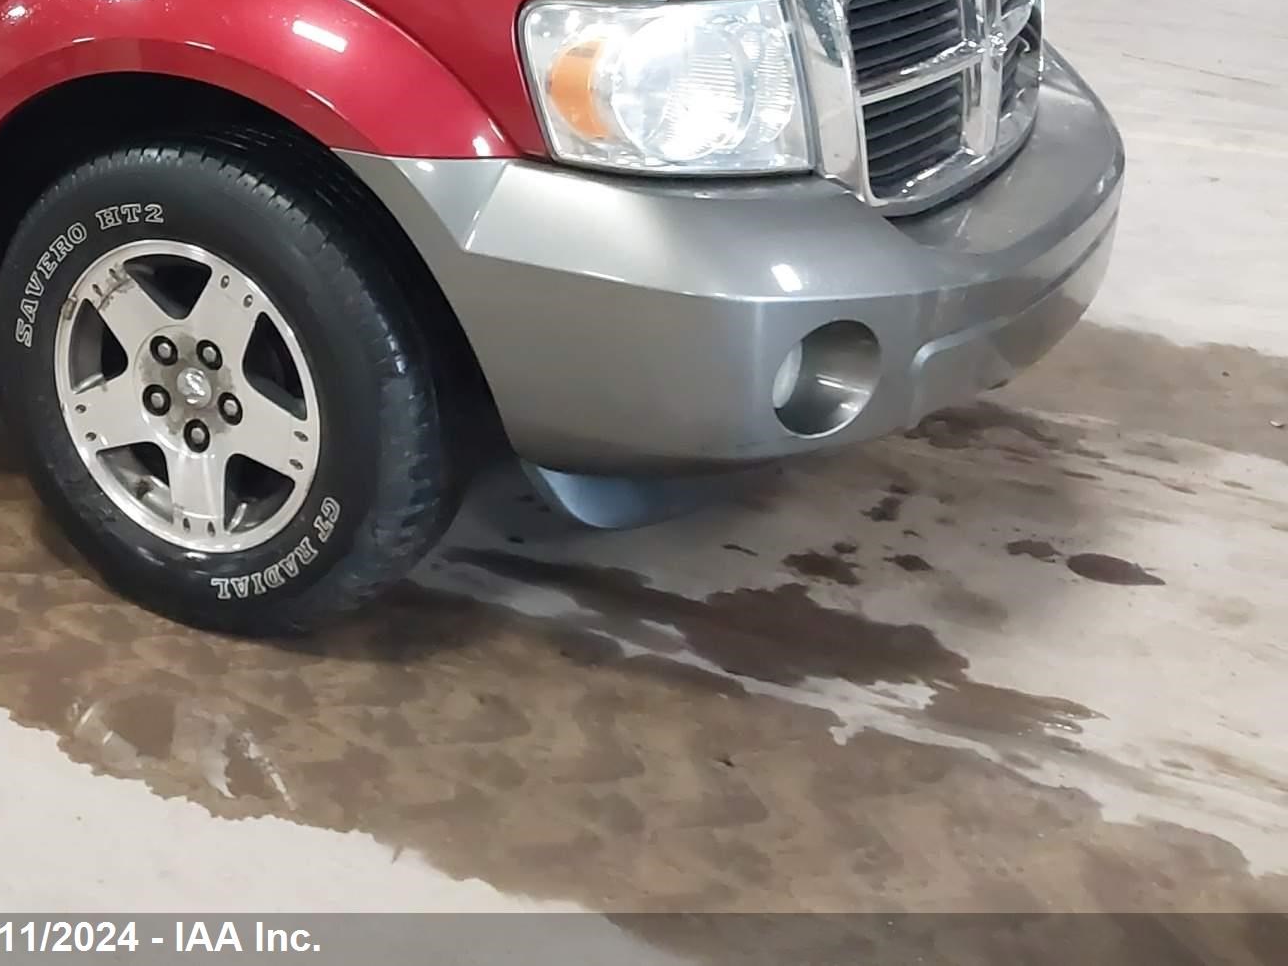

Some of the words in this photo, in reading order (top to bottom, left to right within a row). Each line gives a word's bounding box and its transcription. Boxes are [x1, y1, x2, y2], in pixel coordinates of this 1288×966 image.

[15, 221, 88, 347] SAVERO
[95, 203, 165, 231] HT2
[312, 496, 342, 543] GT
[210, 536, 320, 600] RADIAL
